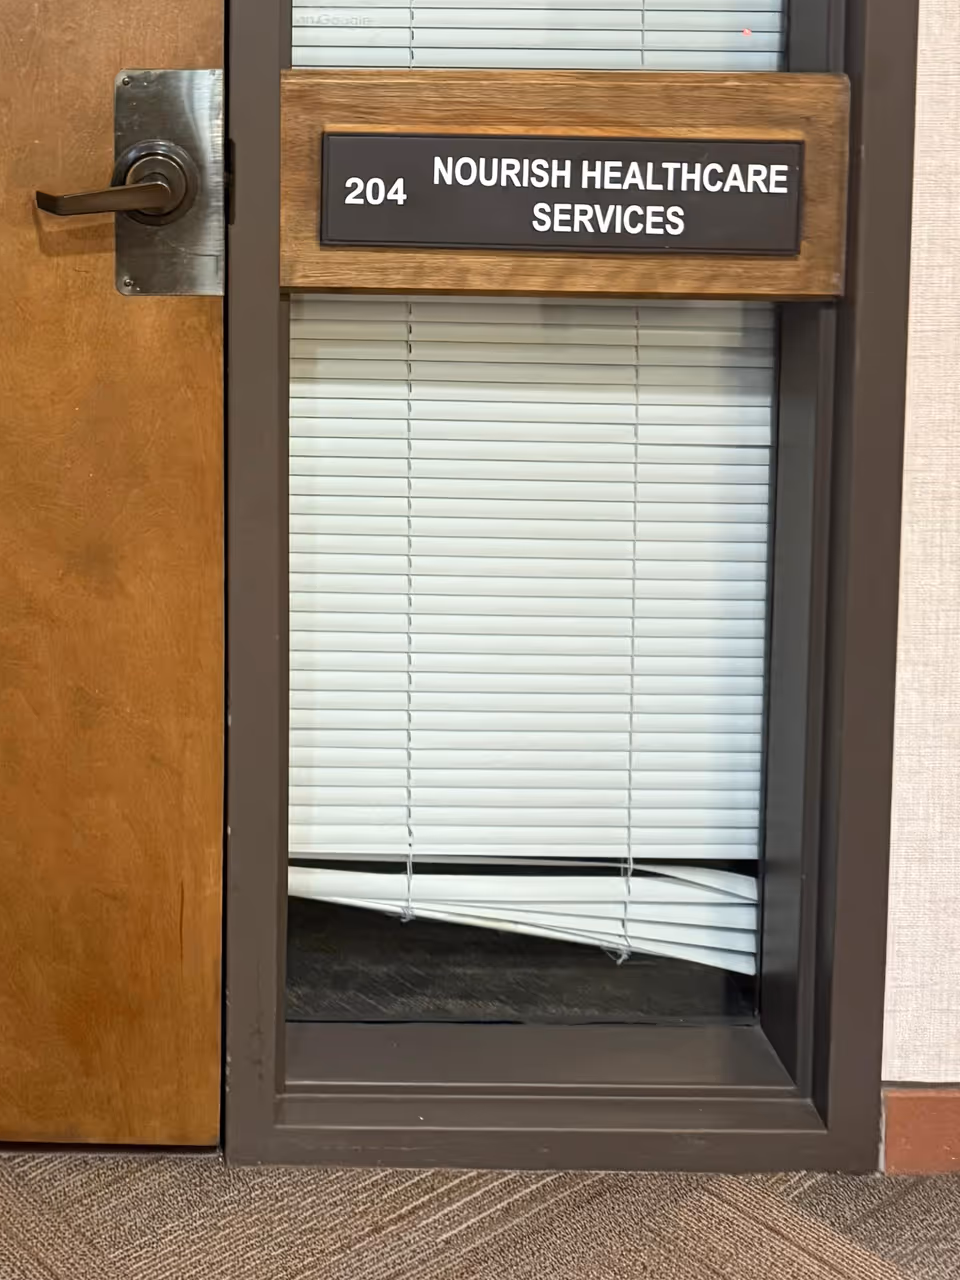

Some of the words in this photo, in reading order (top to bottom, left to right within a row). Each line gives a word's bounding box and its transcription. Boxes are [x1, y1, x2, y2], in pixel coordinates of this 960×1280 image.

[344, 177, 407, 206] 204
[433, 156, 572, 190] NOURISH
[581, 160, 789, 194] HEALTHCARE
[532, 202, 685, 236] SERVICES
